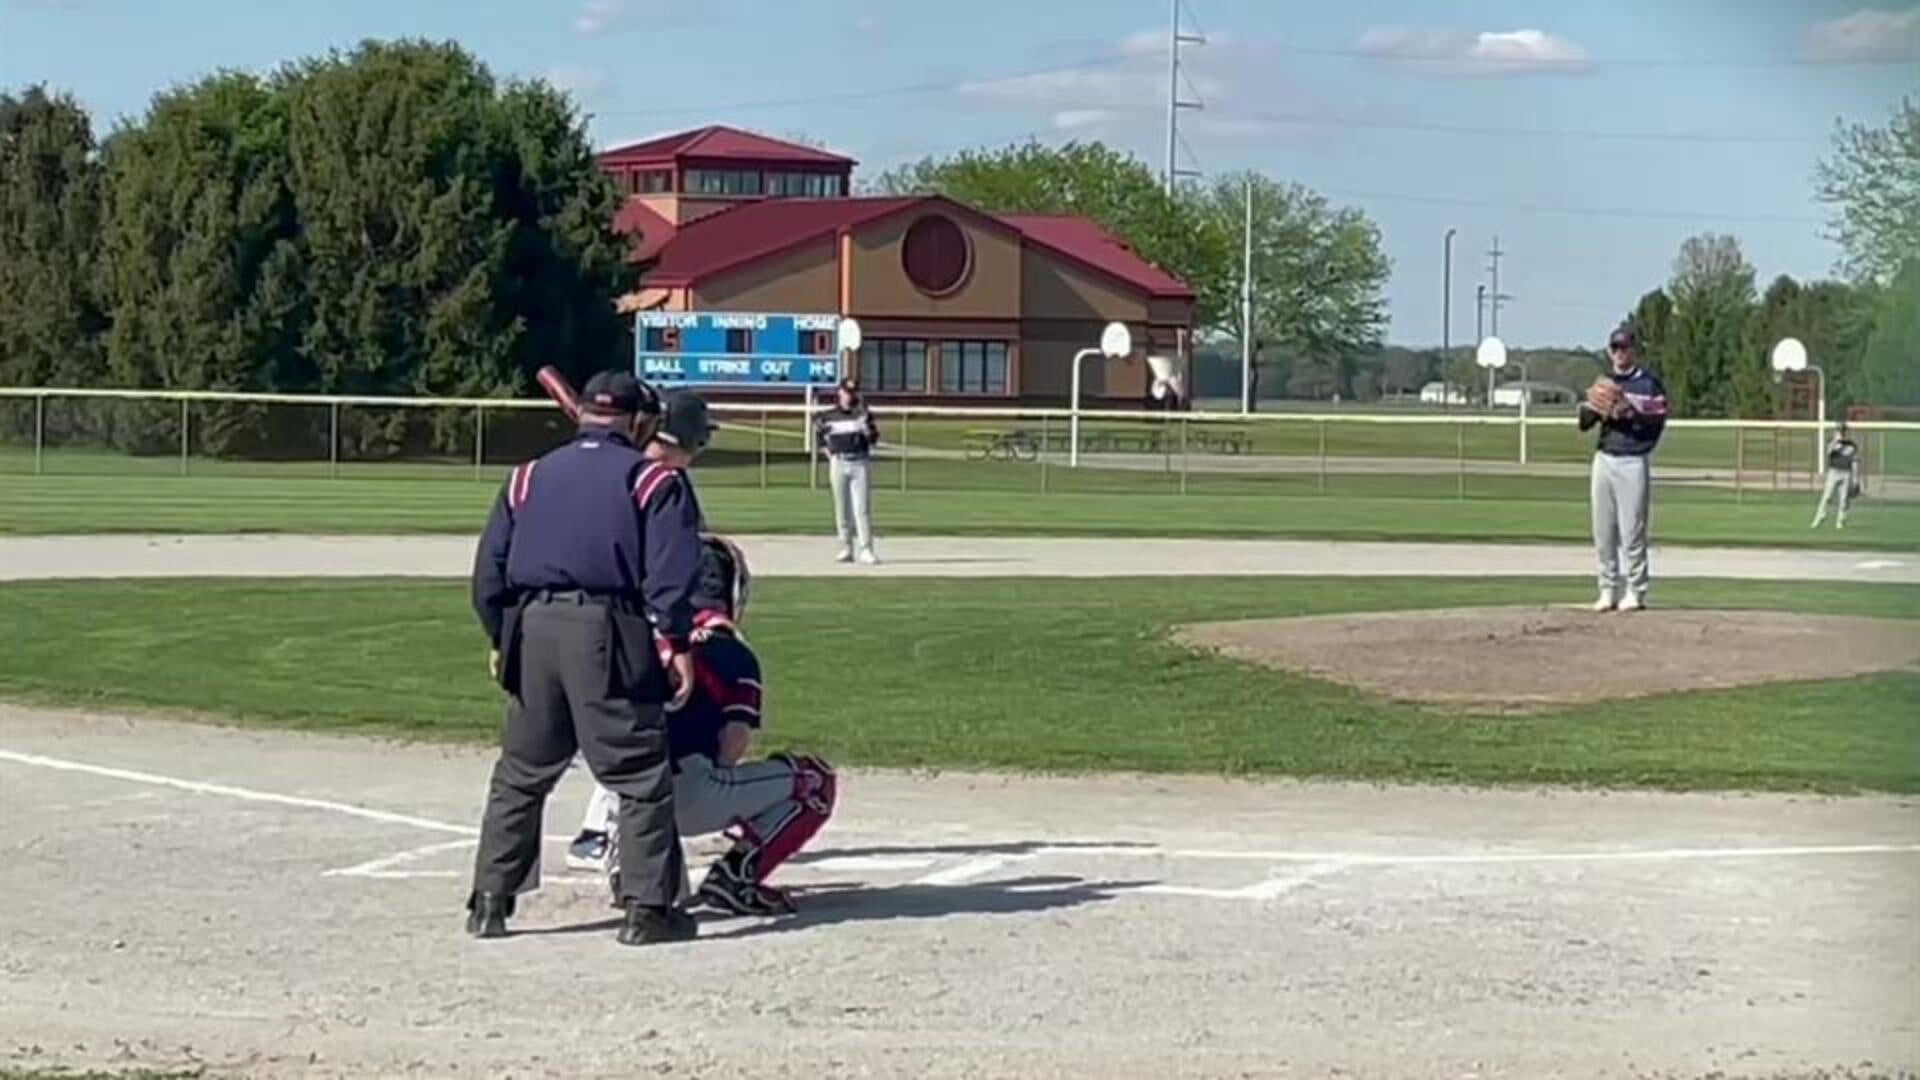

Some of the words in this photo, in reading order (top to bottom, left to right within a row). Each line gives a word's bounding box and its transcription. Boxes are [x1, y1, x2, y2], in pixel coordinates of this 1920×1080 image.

[641, 315, 698, 328] VISITOR
[711, 315, 767, 330] INNING
[794, 316, 836, 331] HOME
[645, 359, 684, 373] BALL
[699, 360, 750, 374] STRIKE
[761, 361, 792, 374] OUT
